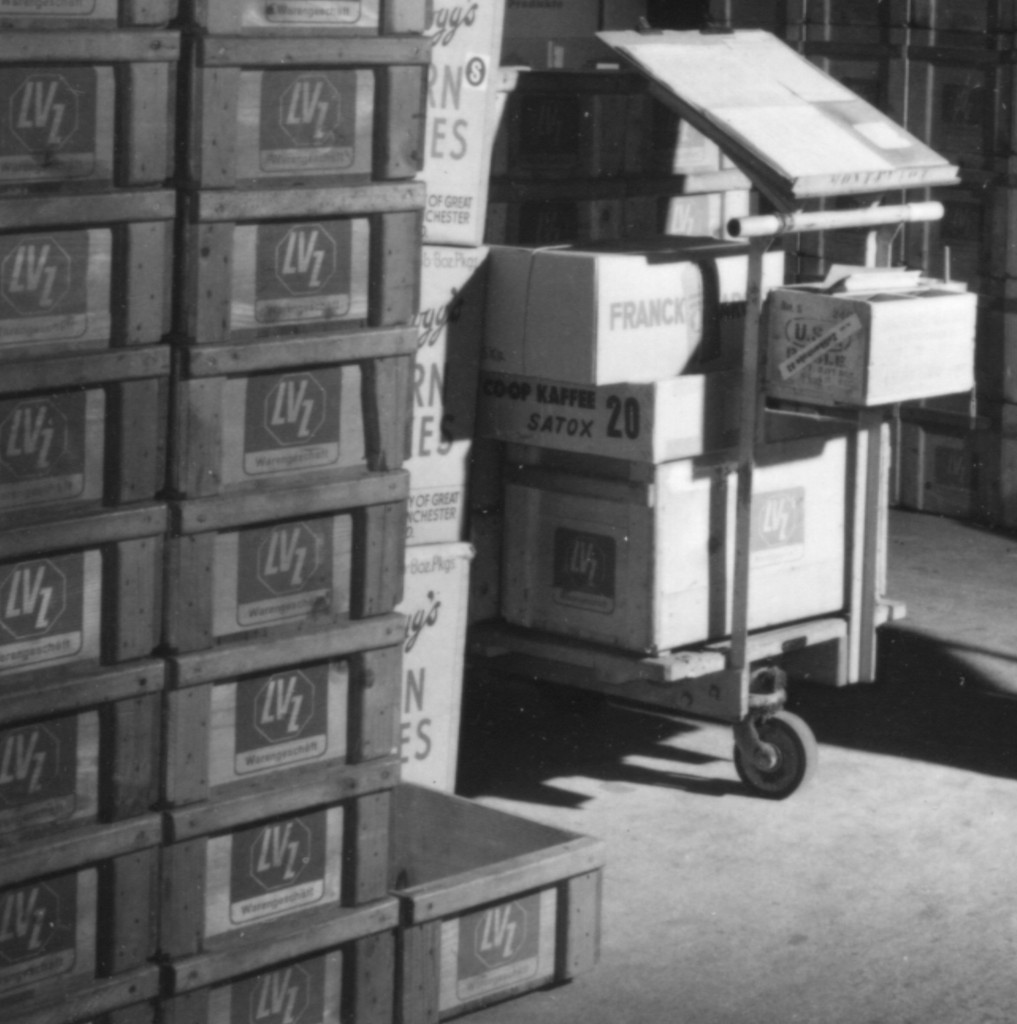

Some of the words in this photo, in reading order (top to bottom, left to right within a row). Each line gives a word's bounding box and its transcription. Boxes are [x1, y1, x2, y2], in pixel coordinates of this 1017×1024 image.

[18, 81, 65, 144] LVZ
[287, 81, 329, 140] LVZ
[427, 62, 464, 112] RN
[425, 209, 470, 225] CHESTER
[428, 194, 443, 208] OF
[444, 194, 473, 210] GREAT
[9, 244, 57, 307] LVZ
[282, 230, 326, 288] LVZ
[609, 297, 687, 331] FRANCK
[271, 380, 314, 438] LVZ
[413, 362, 446, 409] RN
[536, 383, 596, 410] KAFFEE
[6, 406, 54, 468] LVZ
[527, 412, 595, 439] SATOX
[605, 394, 641, 440] 20
[415, 494, 430, 508] OF
[431, 491, 460, 506] GREAT
[264, 528, 307, 587] LVZ
[5, 566, 53, 628] LVZ
[261, 676, 304, 734] LVZ
[257, 823, 300, 881] LVZ
[479, 905, 518, 959] LVZ
